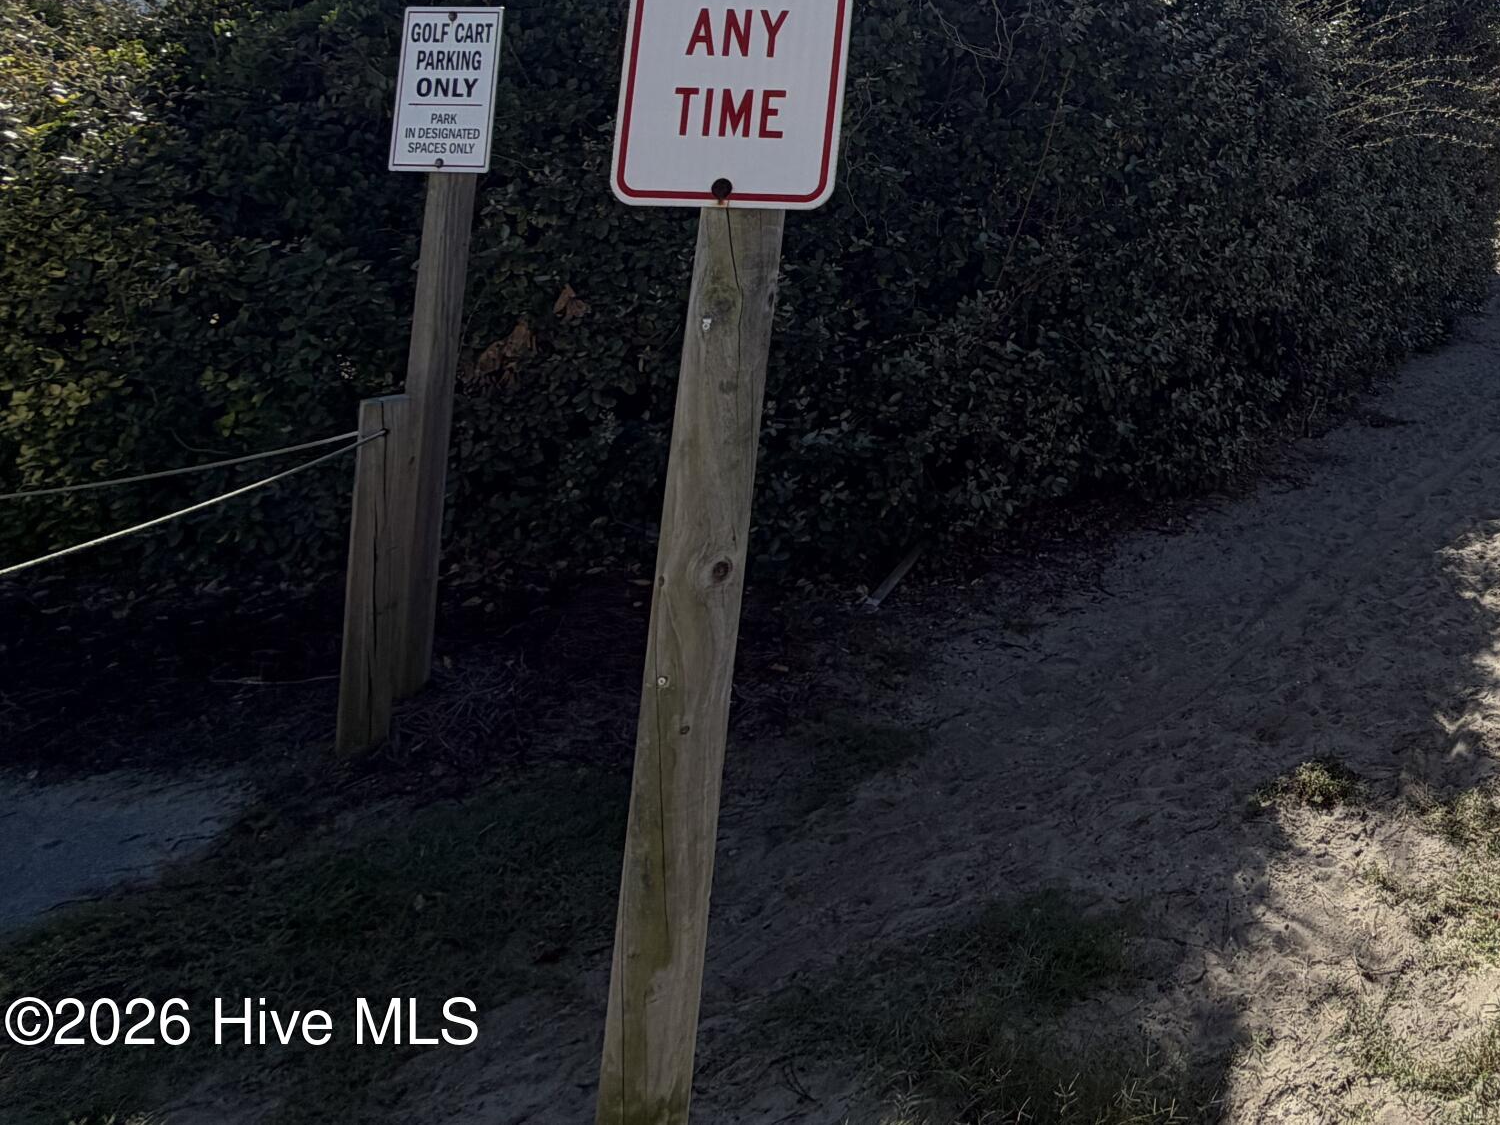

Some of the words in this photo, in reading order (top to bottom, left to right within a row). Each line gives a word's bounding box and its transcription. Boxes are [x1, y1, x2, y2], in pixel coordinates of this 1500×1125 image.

[411, 23, 449, 43] GOLF
[455, 23, 493, 43] CART
[686, 8, 789, 57] ANY
[416, 51, 482, 70] PARKING
[416, 77, 479, 98] ONLY
[430, 113, 457, 124] PARK
[675, 87, 786, 138] TIME
[405, 128, 416, 138] IN
[418, 128, 480, 139] DESIGNATED
[408, 142, 446, 153] SPACES
[449, 143, 475, 154] ONLY
